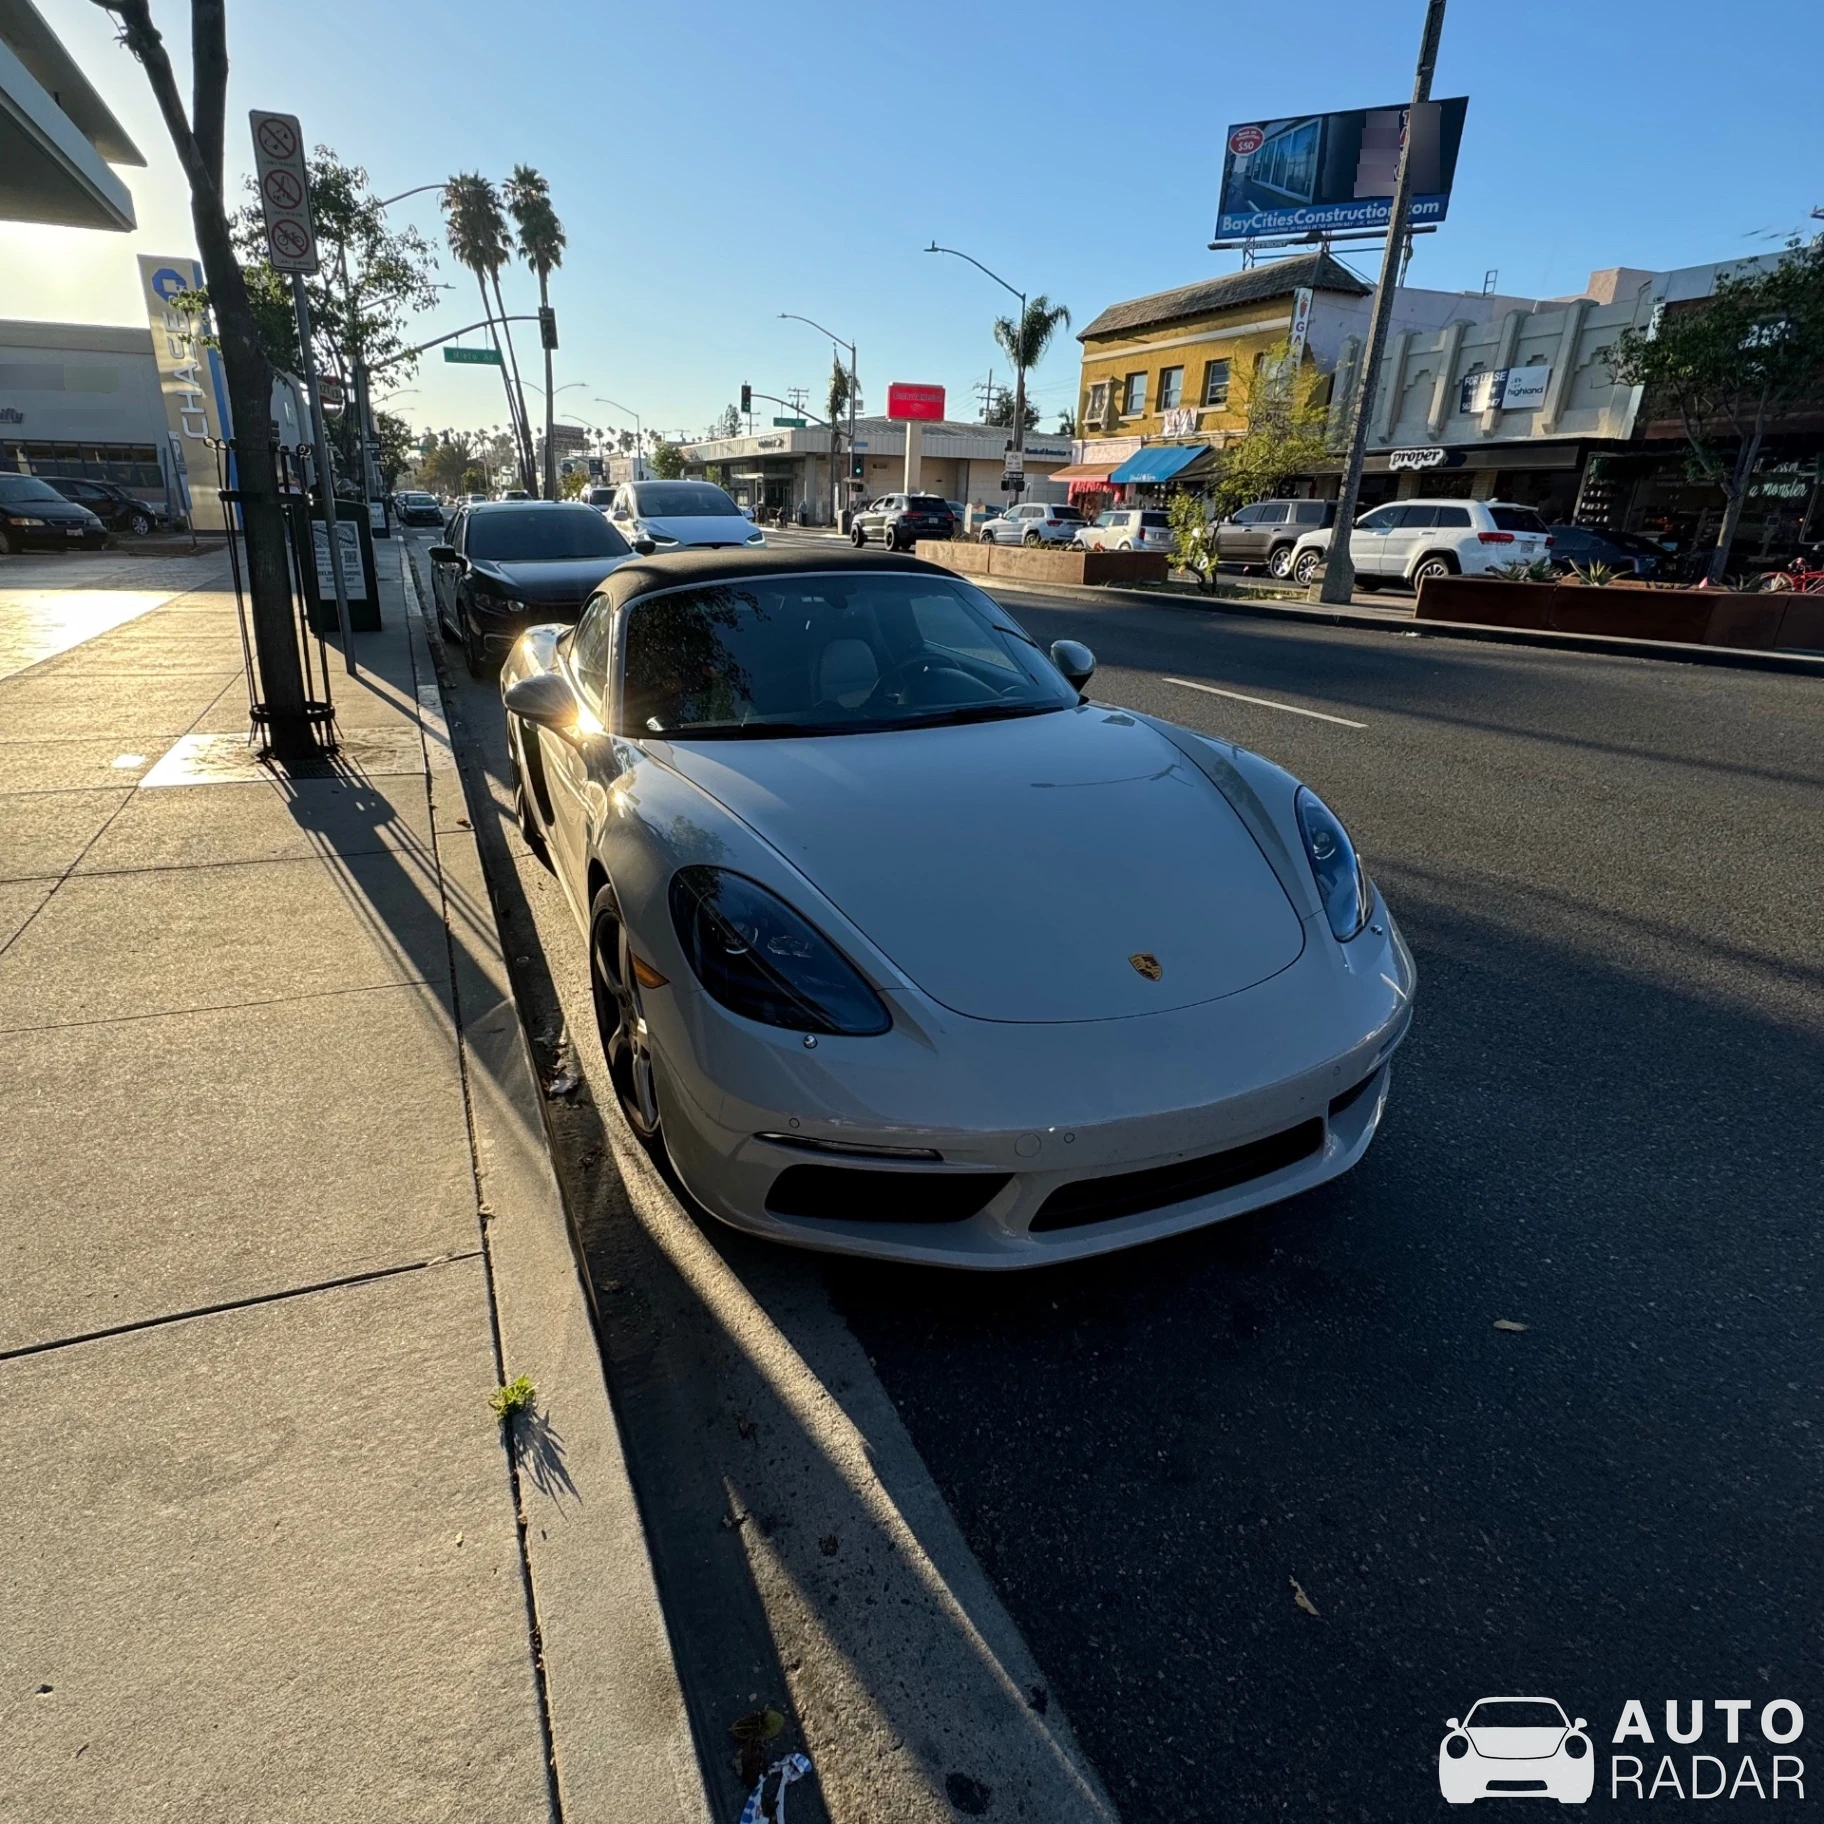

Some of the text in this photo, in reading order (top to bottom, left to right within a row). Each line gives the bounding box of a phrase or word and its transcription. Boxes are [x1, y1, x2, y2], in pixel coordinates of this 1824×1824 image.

[1238, 141, 1254, 152] $50
[1222, 202, 1439, 234] BayCitiesConstructioom
[162, 310, 209, 439] CHASE
[1464, 371, 1507, 386] FOR LESE
[1507, 386, 1544, 397] highland
[0, 408, 23, 424] ifty
[1391, 450, 1441, 466] proper
